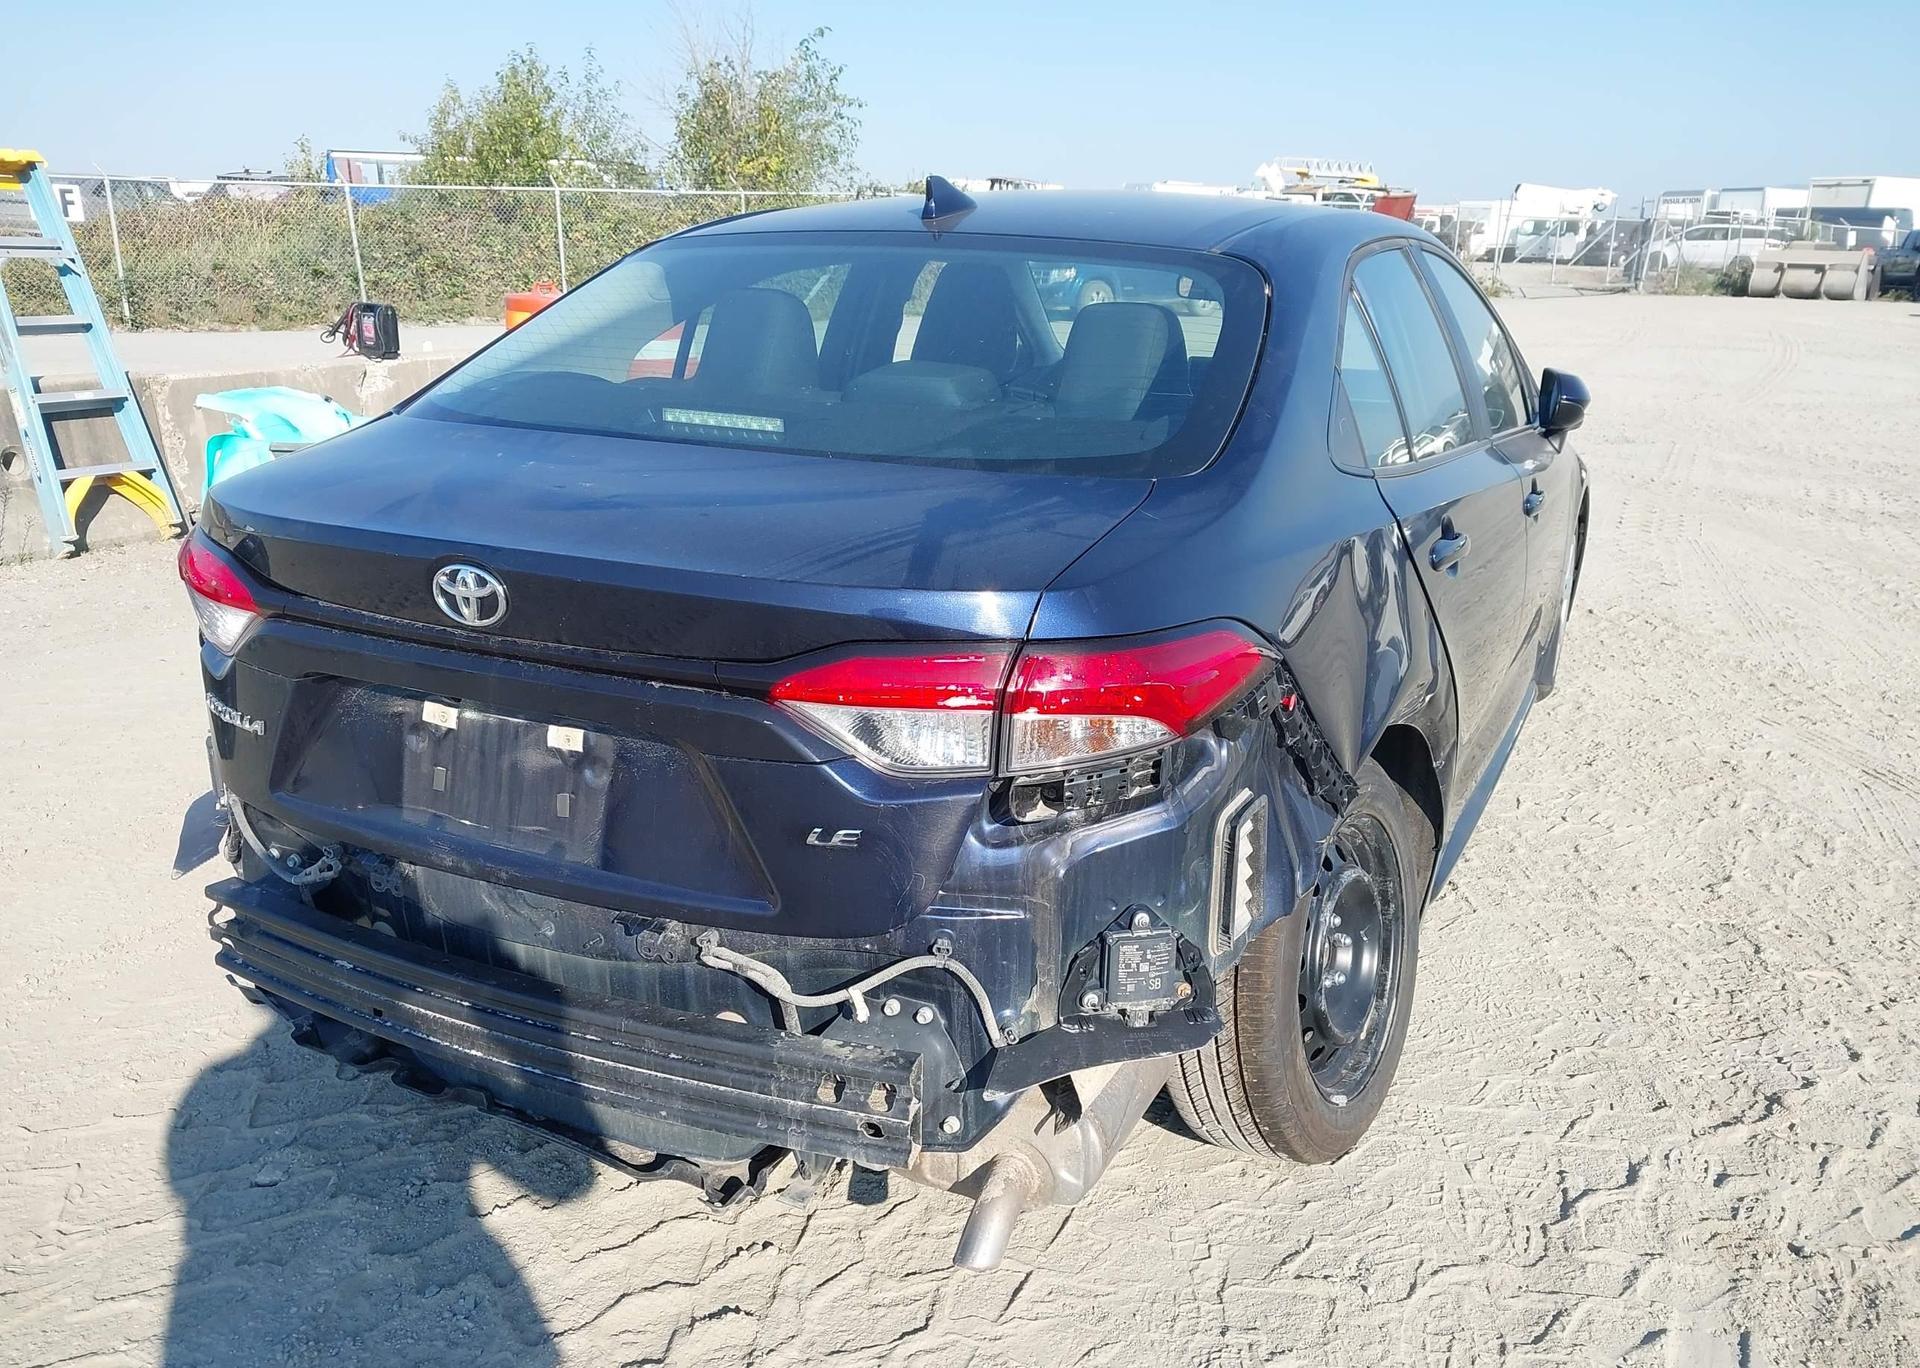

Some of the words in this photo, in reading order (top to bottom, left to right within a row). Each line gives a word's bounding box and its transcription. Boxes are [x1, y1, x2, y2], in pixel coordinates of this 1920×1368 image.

[59, 188, 75, 218] F
[1663, 196, 1701, 205] INSULATION
[806, 827, 864, 848] LE
[1149, 978, 1161, 991] SB
